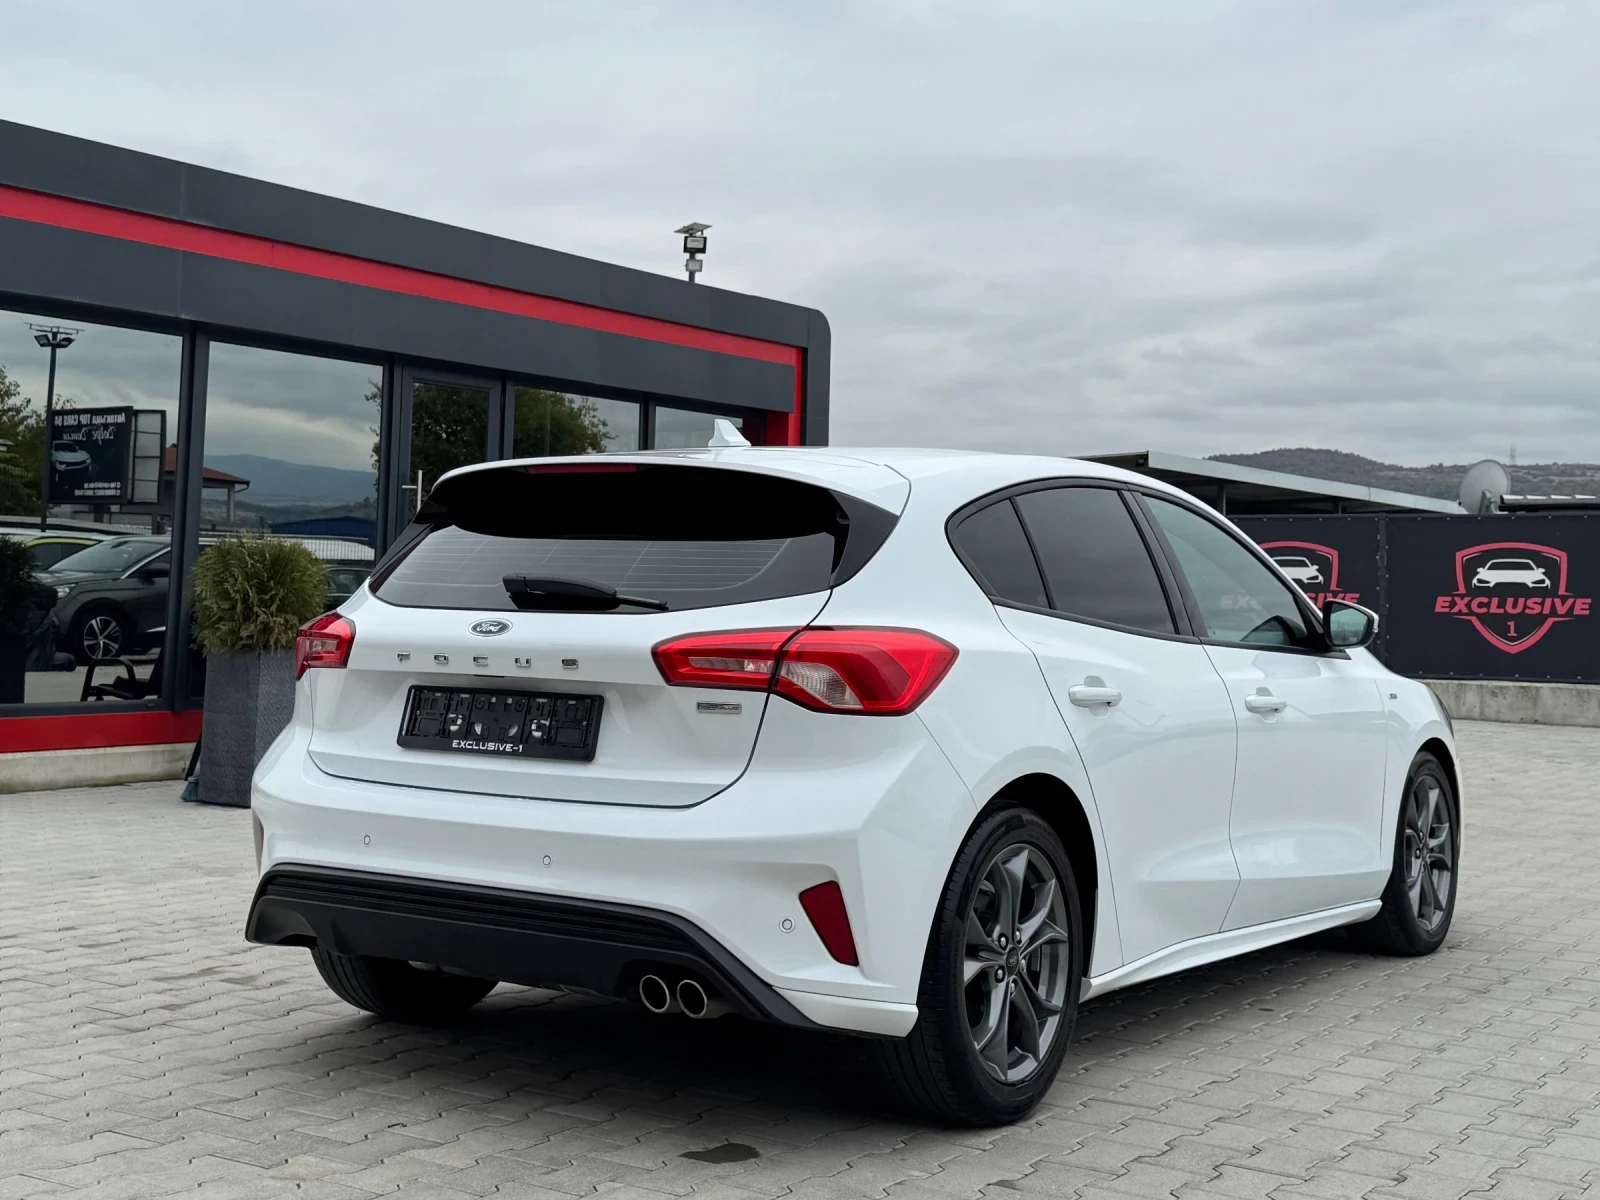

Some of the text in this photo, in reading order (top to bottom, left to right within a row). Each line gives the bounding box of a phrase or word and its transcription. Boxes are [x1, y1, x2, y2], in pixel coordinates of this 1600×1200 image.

[1434, 596, 1592, 616] EXCLUSIVE
[1506, 621, 1518, 637] 1
[397, 652, 579, 669] FOCUS
[452, 739, 523, 753] EXCLUSIVE-1
